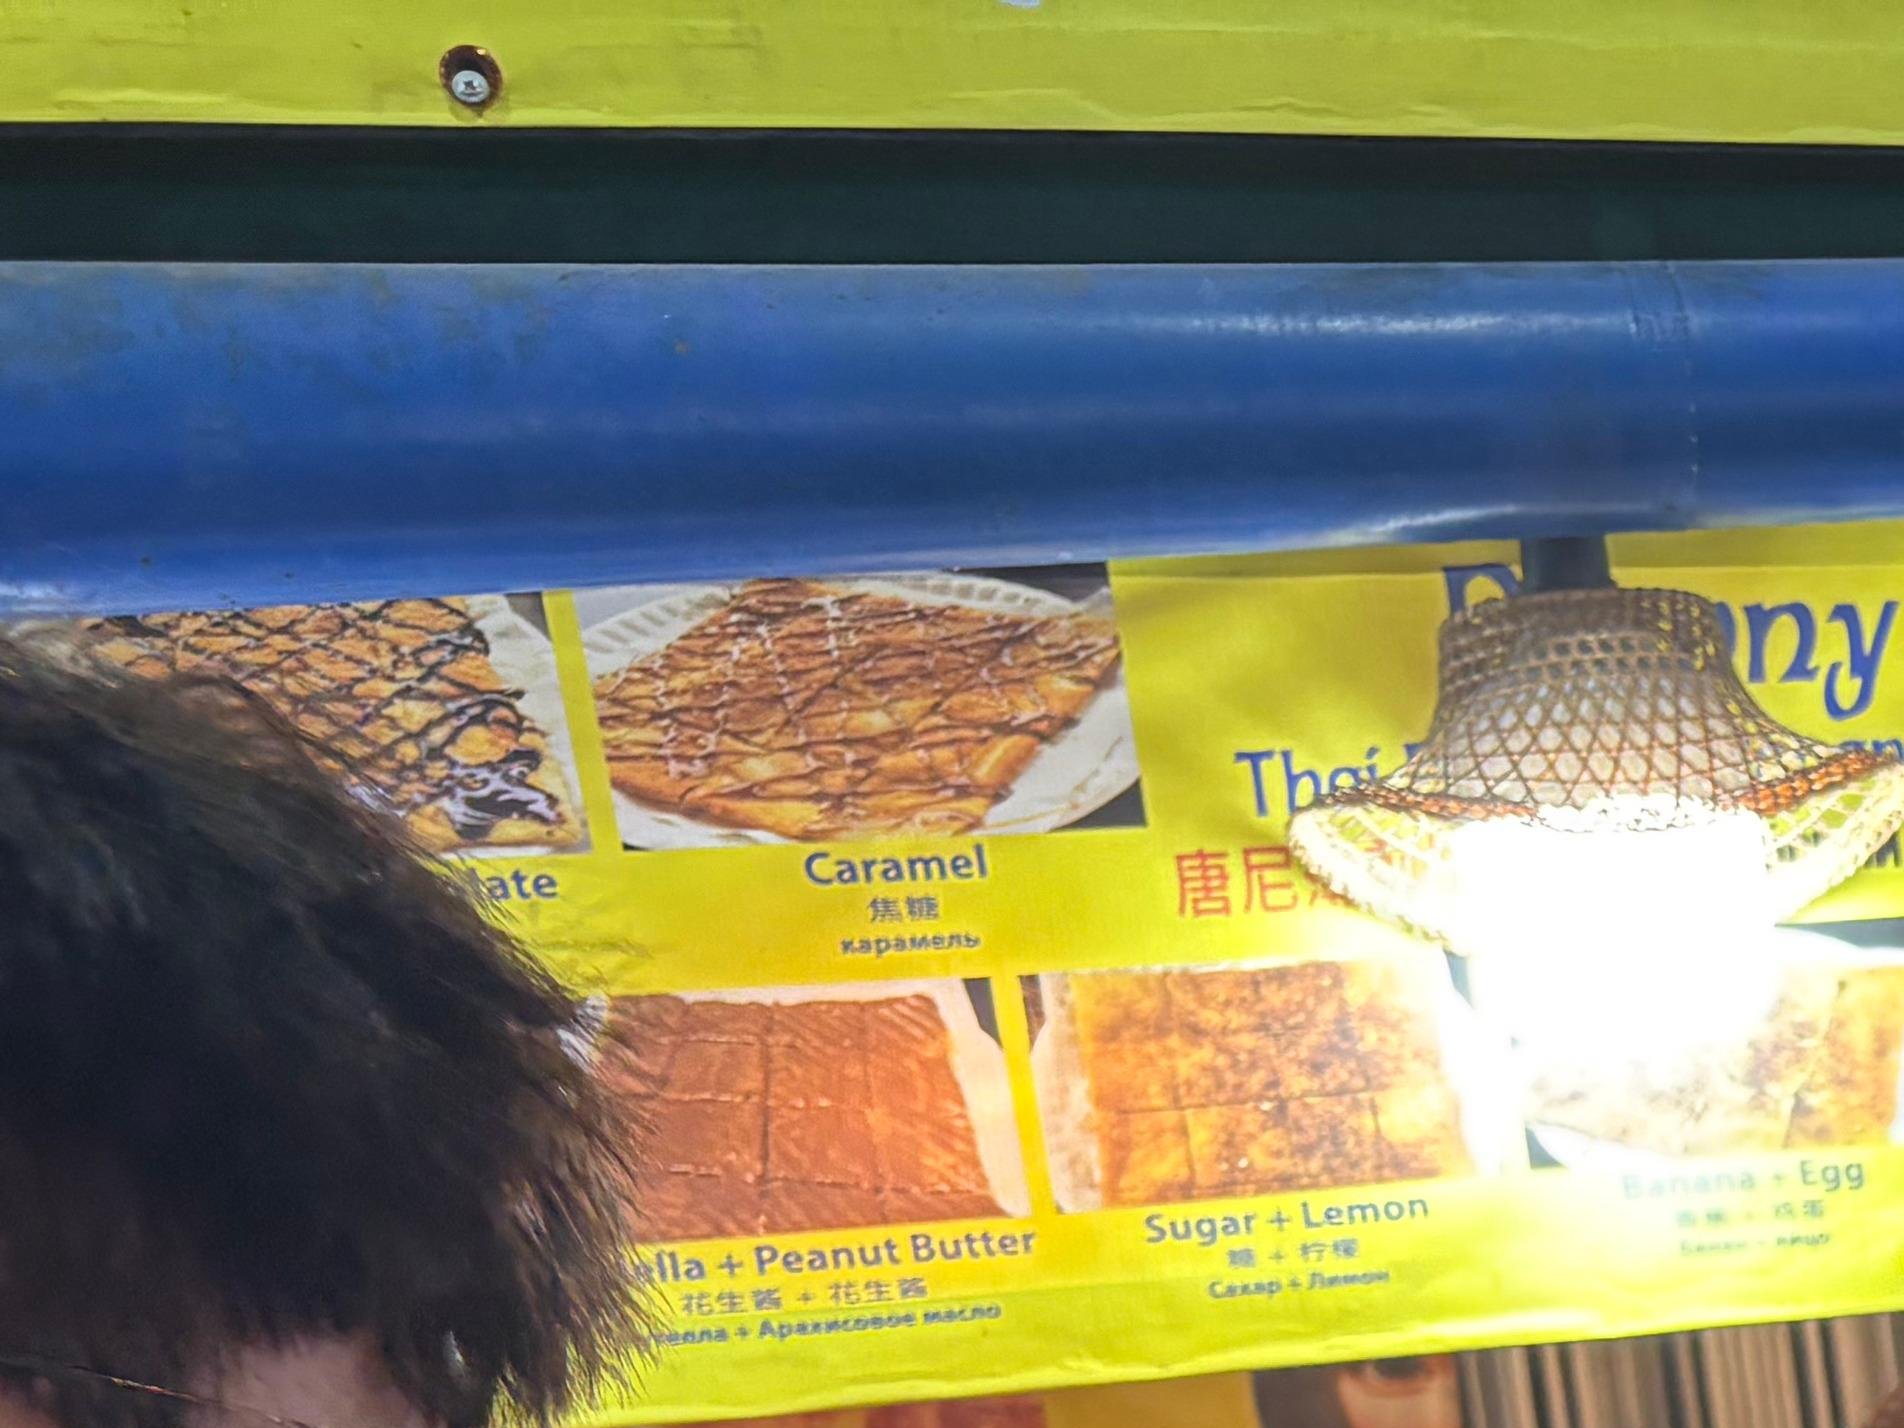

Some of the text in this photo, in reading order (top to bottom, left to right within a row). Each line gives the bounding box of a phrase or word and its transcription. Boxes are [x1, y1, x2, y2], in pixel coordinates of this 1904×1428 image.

[803, 843, 989, 886] Caramel
[486, 867, 558, 901] ate
[840, 931, 982, 958] карамель
[1799, 1159, 1866, 1193] Egg
[1144, 1212, 1257, 1247] Sugar
[1301, 1198, 1430, 1229] Lemon
[754, 1238, 900, 1277] Peanut
[910, 1229, 1036, 1263] Butter
